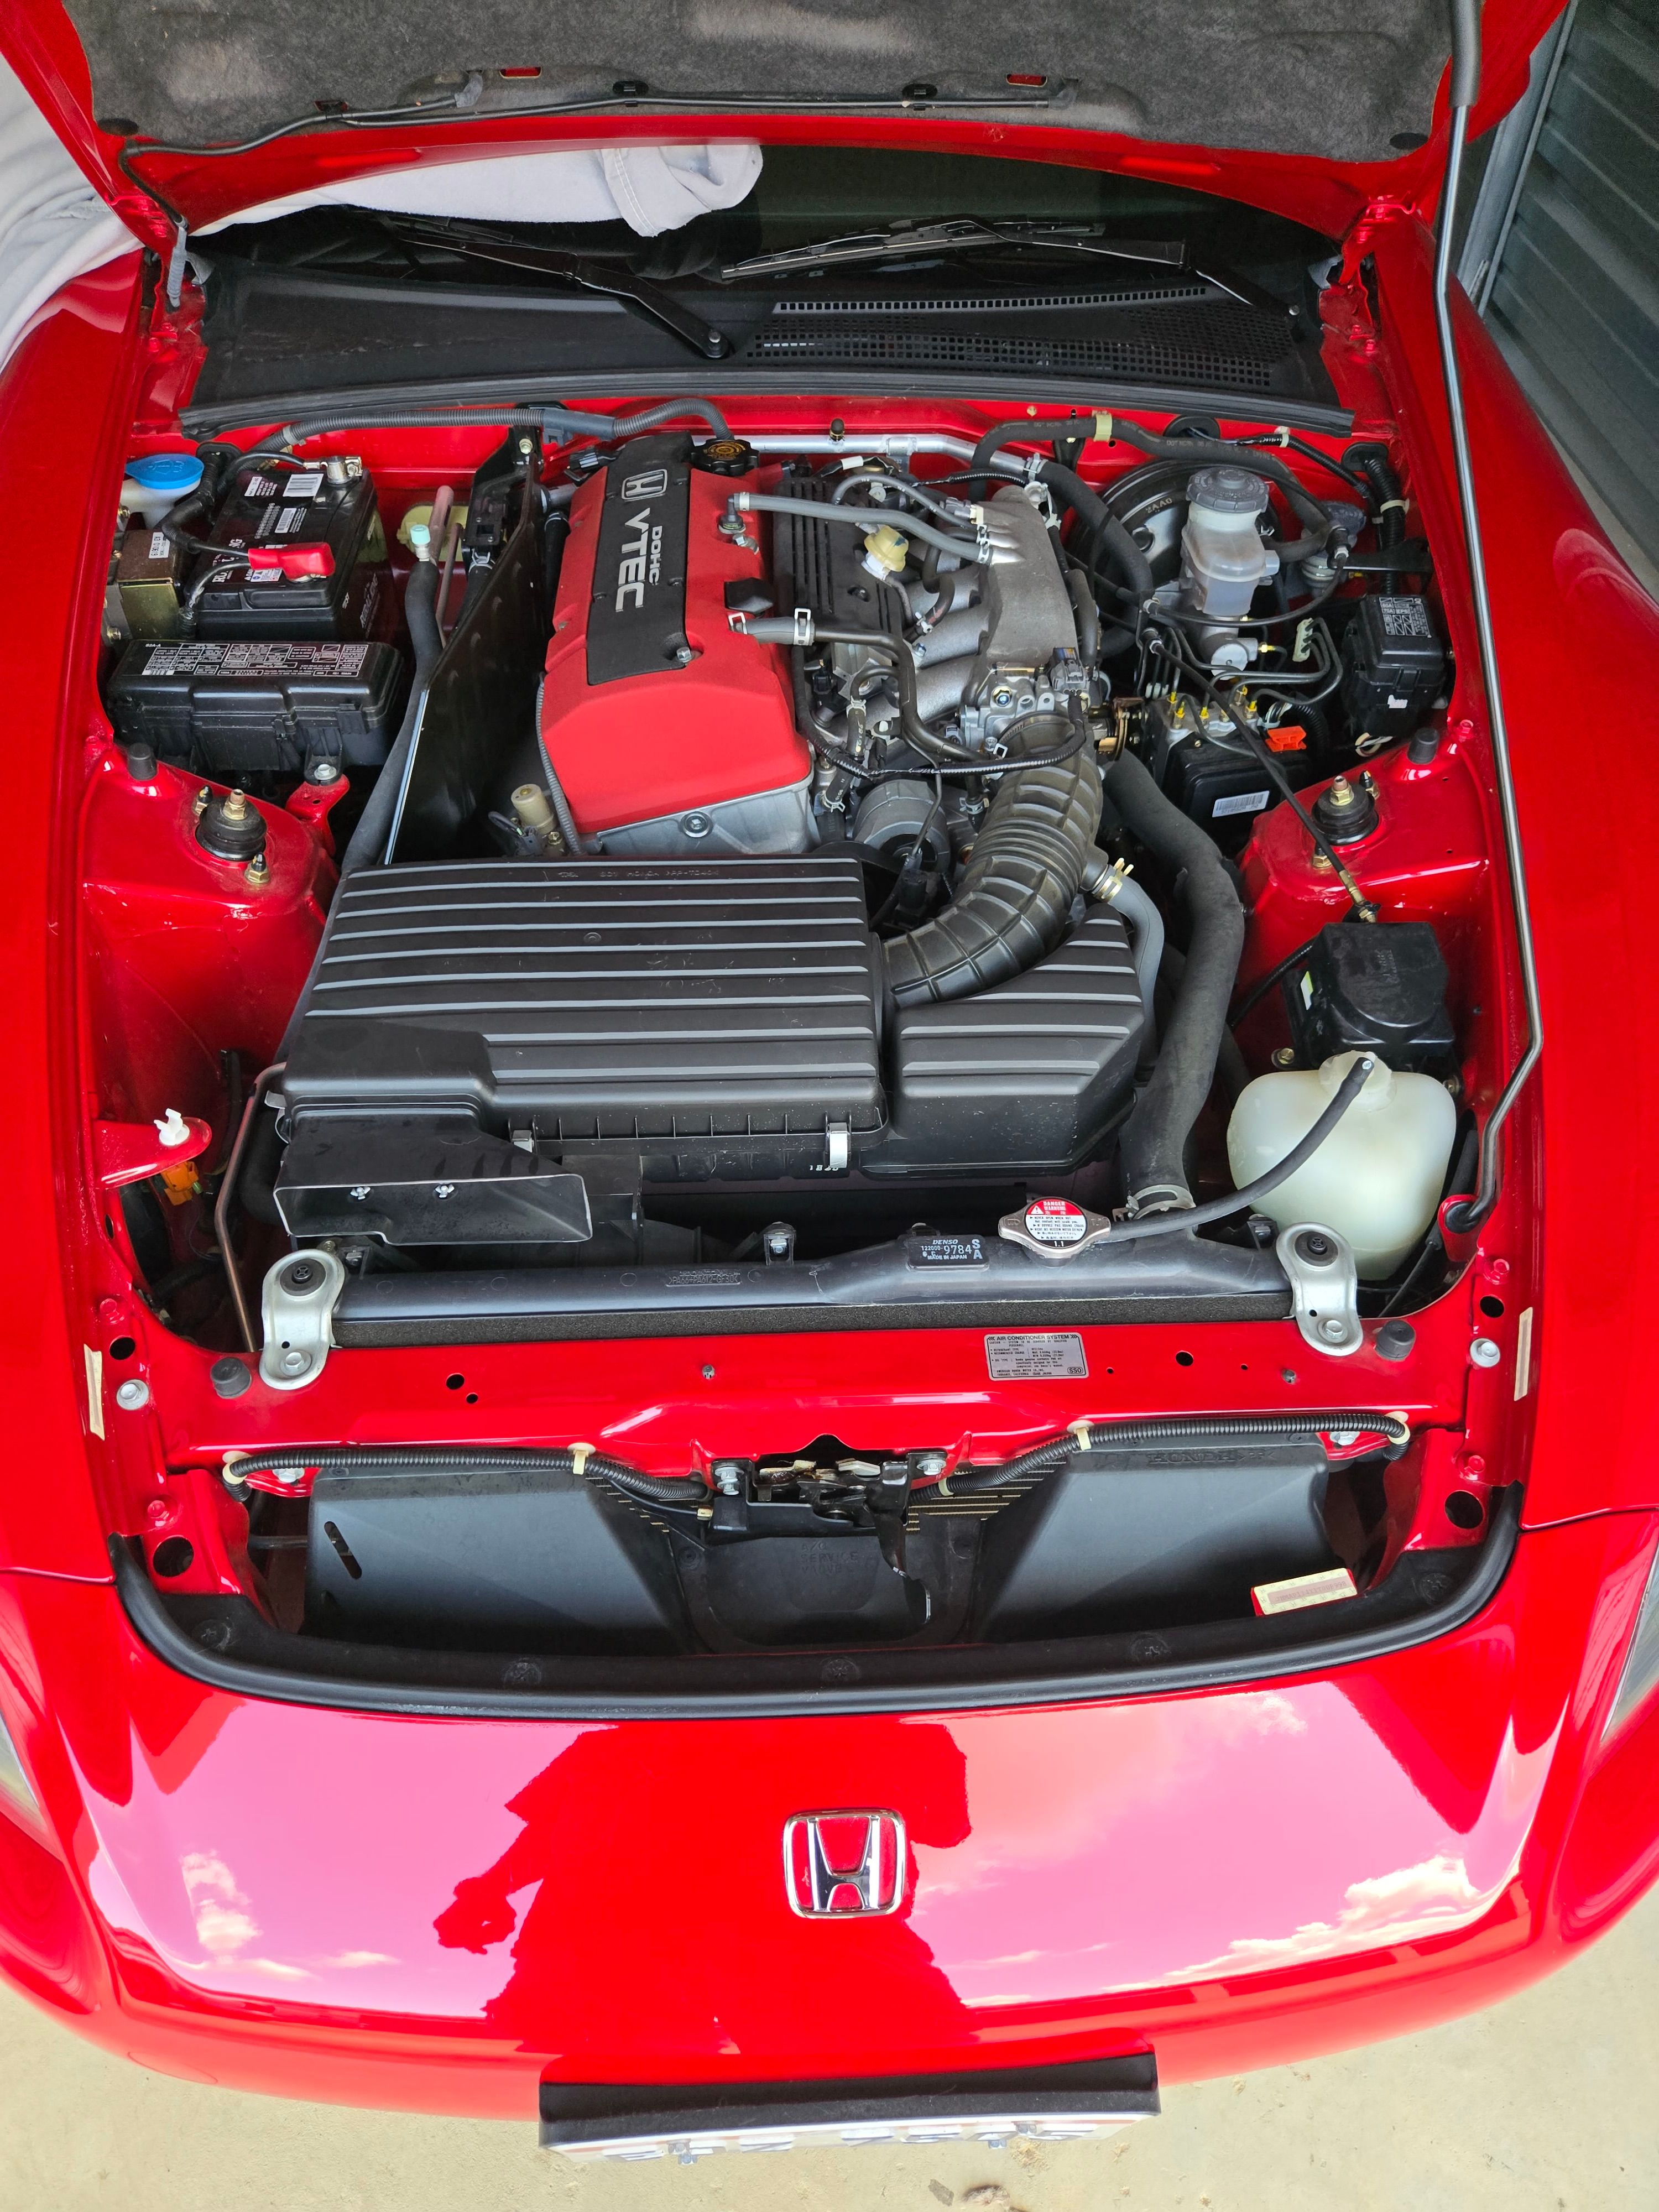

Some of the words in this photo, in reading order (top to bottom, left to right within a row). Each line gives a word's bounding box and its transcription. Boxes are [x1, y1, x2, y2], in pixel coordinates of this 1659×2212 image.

[615, 507, 650, 612] VTEC
[649, 525, 662, 586] DOHC
[972, 1239, 980, 1249] S
[973, 1249, 983, 1259] A
[1147, 1451, 1237, 1464] HONDA
[801, 1552, 859, 1563] SERVICE
